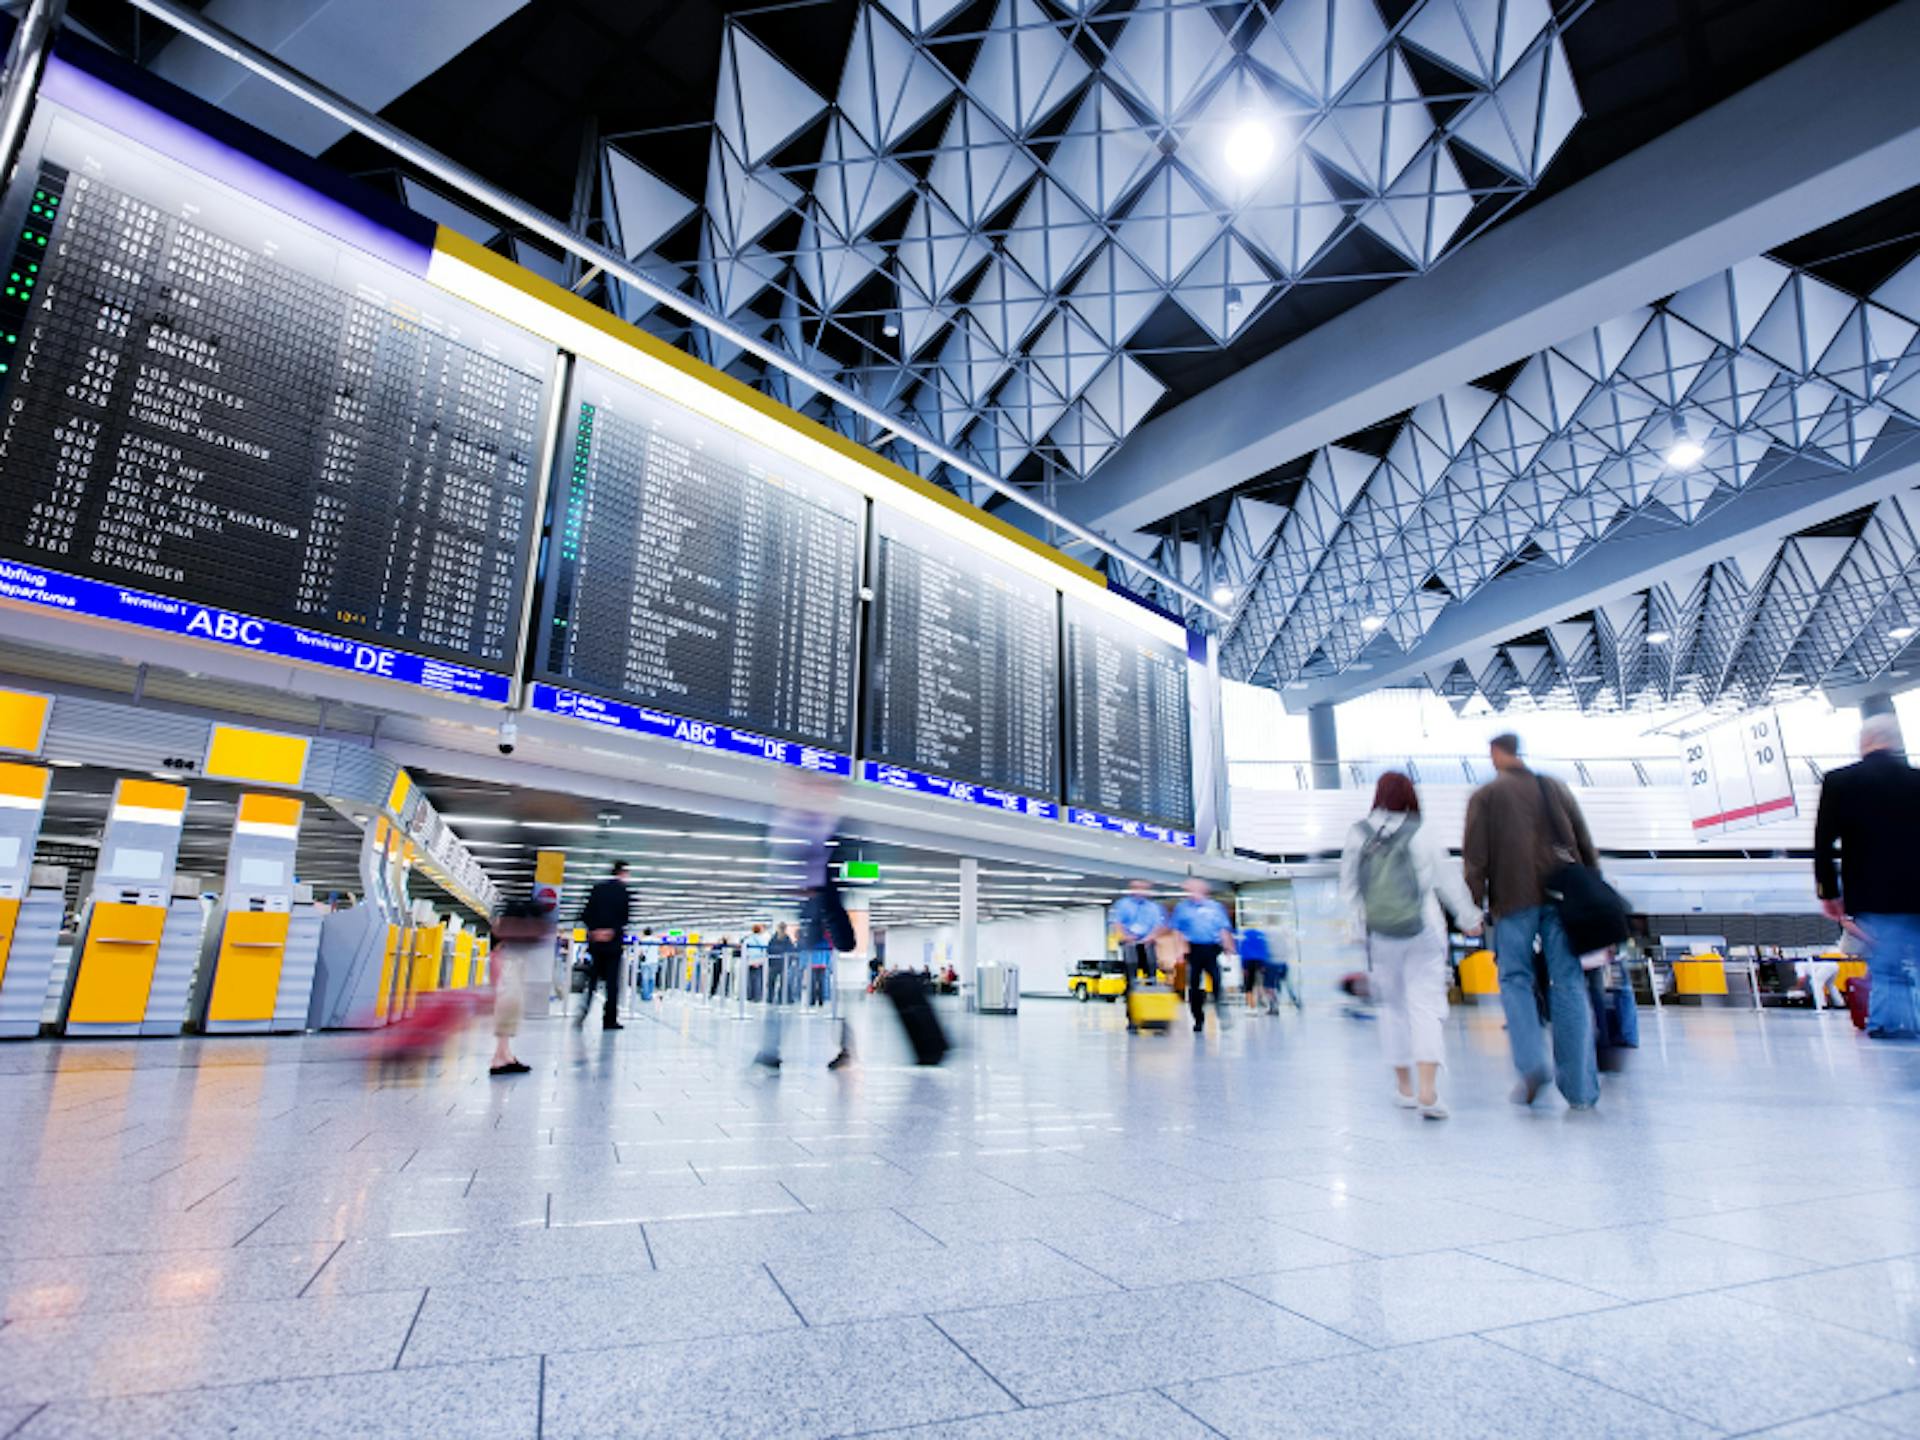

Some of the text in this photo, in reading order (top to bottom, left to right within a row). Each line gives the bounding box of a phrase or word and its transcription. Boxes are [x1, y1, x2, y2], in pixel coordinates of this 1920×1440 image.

[147, 337, 221, 373] MONTREAL
[150, 325, 217, 357] CALGARY
[136, 378, 202, 409] DETROIT
[141, 364, 170, 383] LOS
[179, 378, 244, 410] ANGELES
[132, 391, 202, 423] HOUSTON
[122, 433, 182, 461] ZAGREB
[128, 405, 270, 460] LONDON-HEATHROW
[118, 448, 169, 472] KOELN
[110, 476, 161, 500] ADDIS
[117, 462, 141, 479] TEL
[155, 474, 195, 493] AVIV
[102, 505, 194, 539] LJUBLJANA
[107, 490, 224, 533] BERLIN-TEGEL
[95, 534, 157, 560] BERGEN
[100, 520, 162, 545] DUBLIN
[91, 550, 184, 582] STAVANGER
[119, 592, 179, 614] Terminal
[187, 610, 265, 645] ABC
[294, 631, 344, 651] Terminal
[354, 646, 395, 676] DE
[674, 721, 717, 745] ABC
[764, 740, 786, 761] DE
[1750, 722, 1768, 739] 10
[1687, 745, 1703, 762] 20
[1755, 746, 1774, 765] 10
[950, 781, 975, 800] ABC
[1692, 770, 1707, 786] 20
